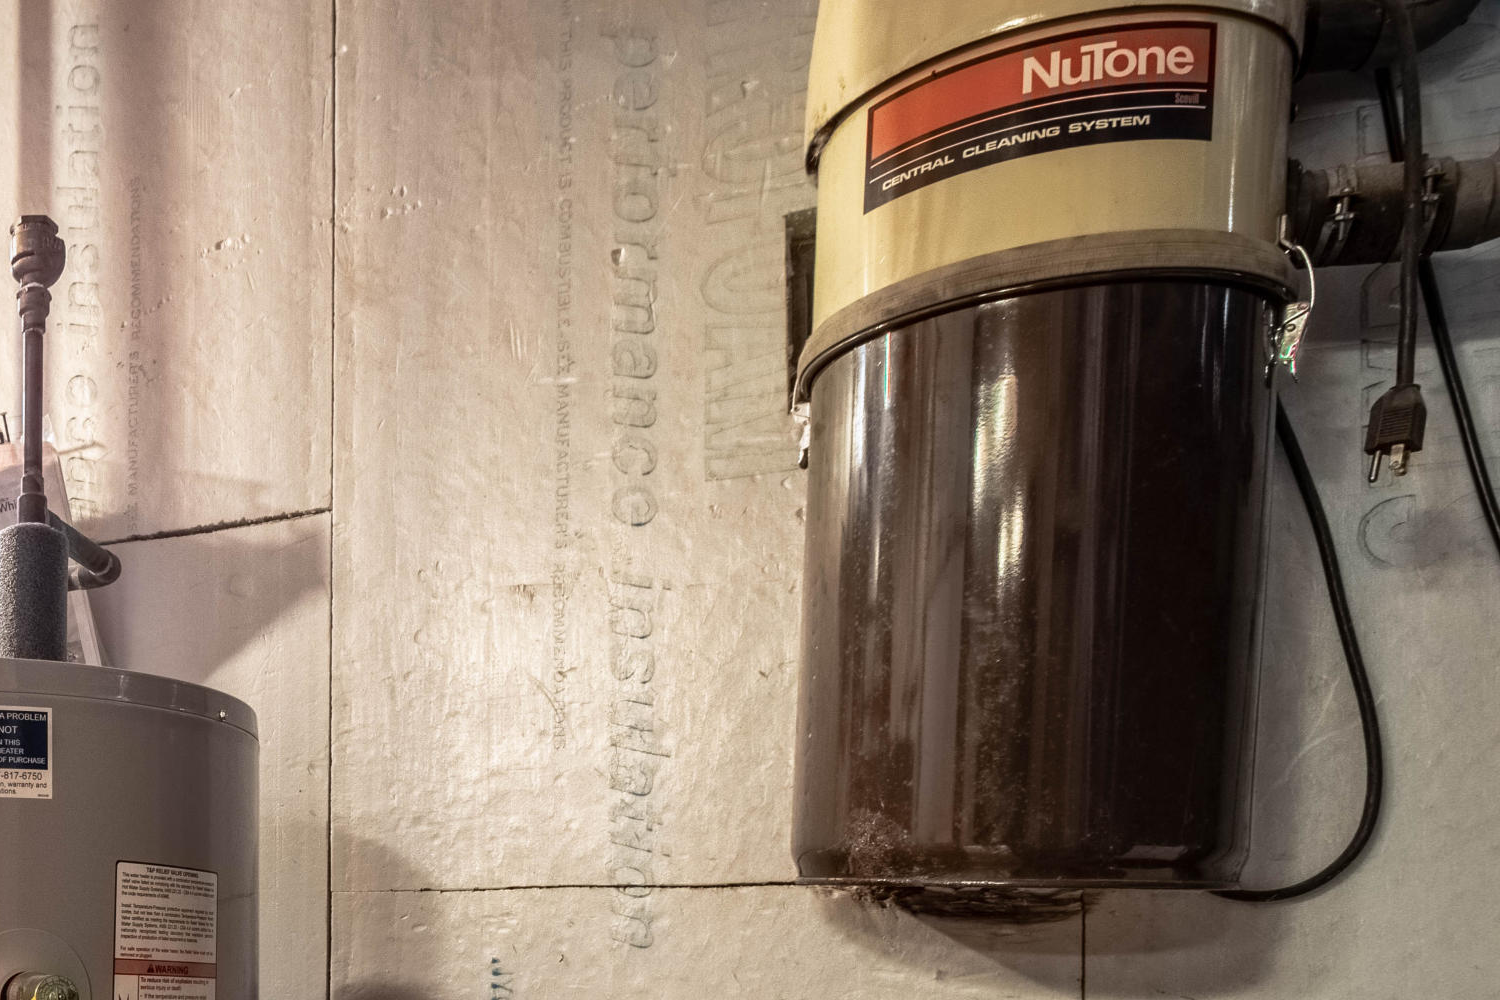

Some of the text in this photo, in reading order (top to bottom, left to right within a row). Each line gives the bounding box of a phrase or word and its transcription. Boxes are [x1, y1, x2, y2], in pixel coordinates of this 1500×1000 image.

[1022, 41, 1195, 95] NuTone
[882, 114, 1151, 191] CENTRAL CLEANING SYSTEM
[130, 175, 142, 343] RECOMMENDATIONS
[600, 28, 677, 528] performance
[0, 712, 5, 720] A
[6, 712, 47, 721] PROBLEM
[8, 756, 46, 765] PURCHASE
[7, 781, 34, 790] warranty
[35, 781, 48, 789] and
[155, 964, 189, 975] WARNING
